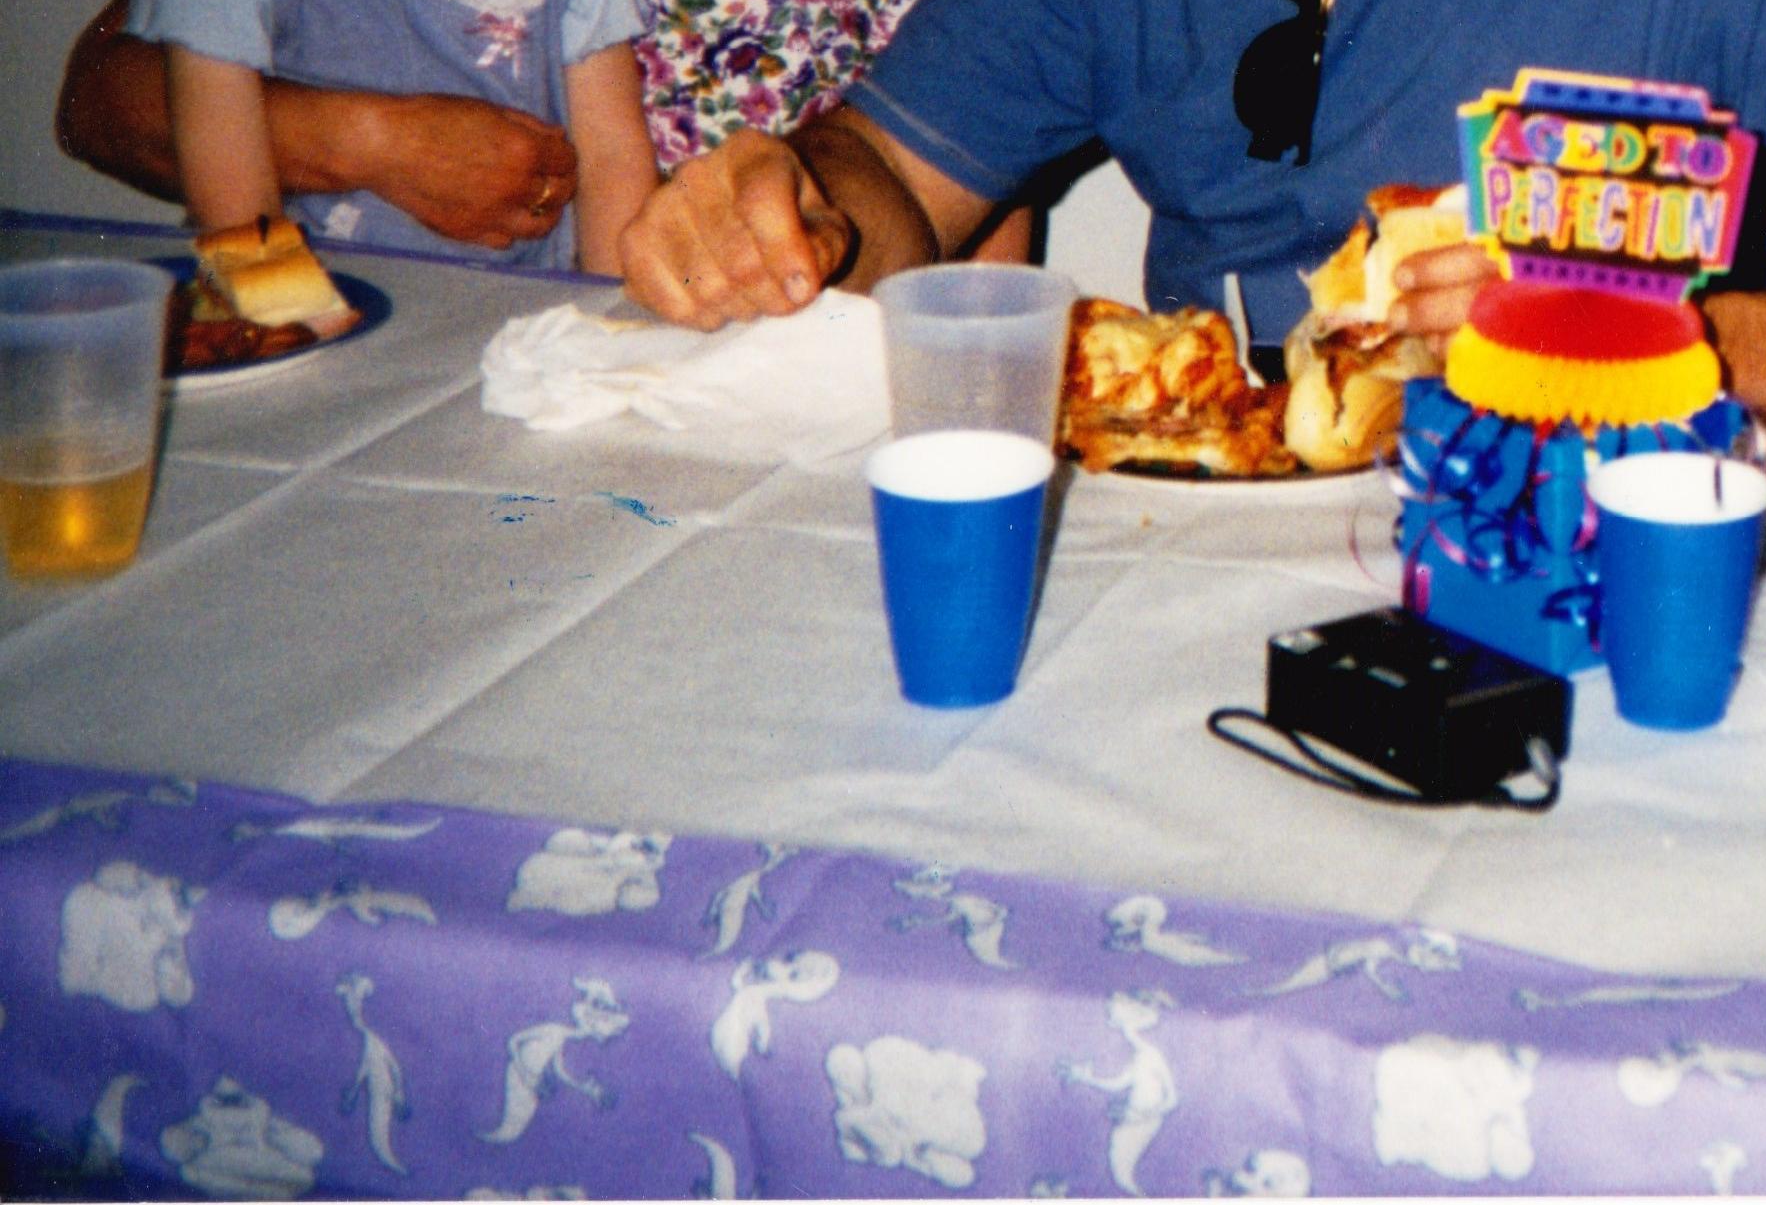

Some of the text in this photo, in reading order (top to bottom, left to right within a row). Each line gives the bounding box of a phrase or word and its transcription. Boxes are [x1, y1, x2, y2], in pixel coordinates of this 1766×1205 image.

[1481, 108, 1733, 183] AGED TO
[1482, 161, 1728, 261] PERFECTION
